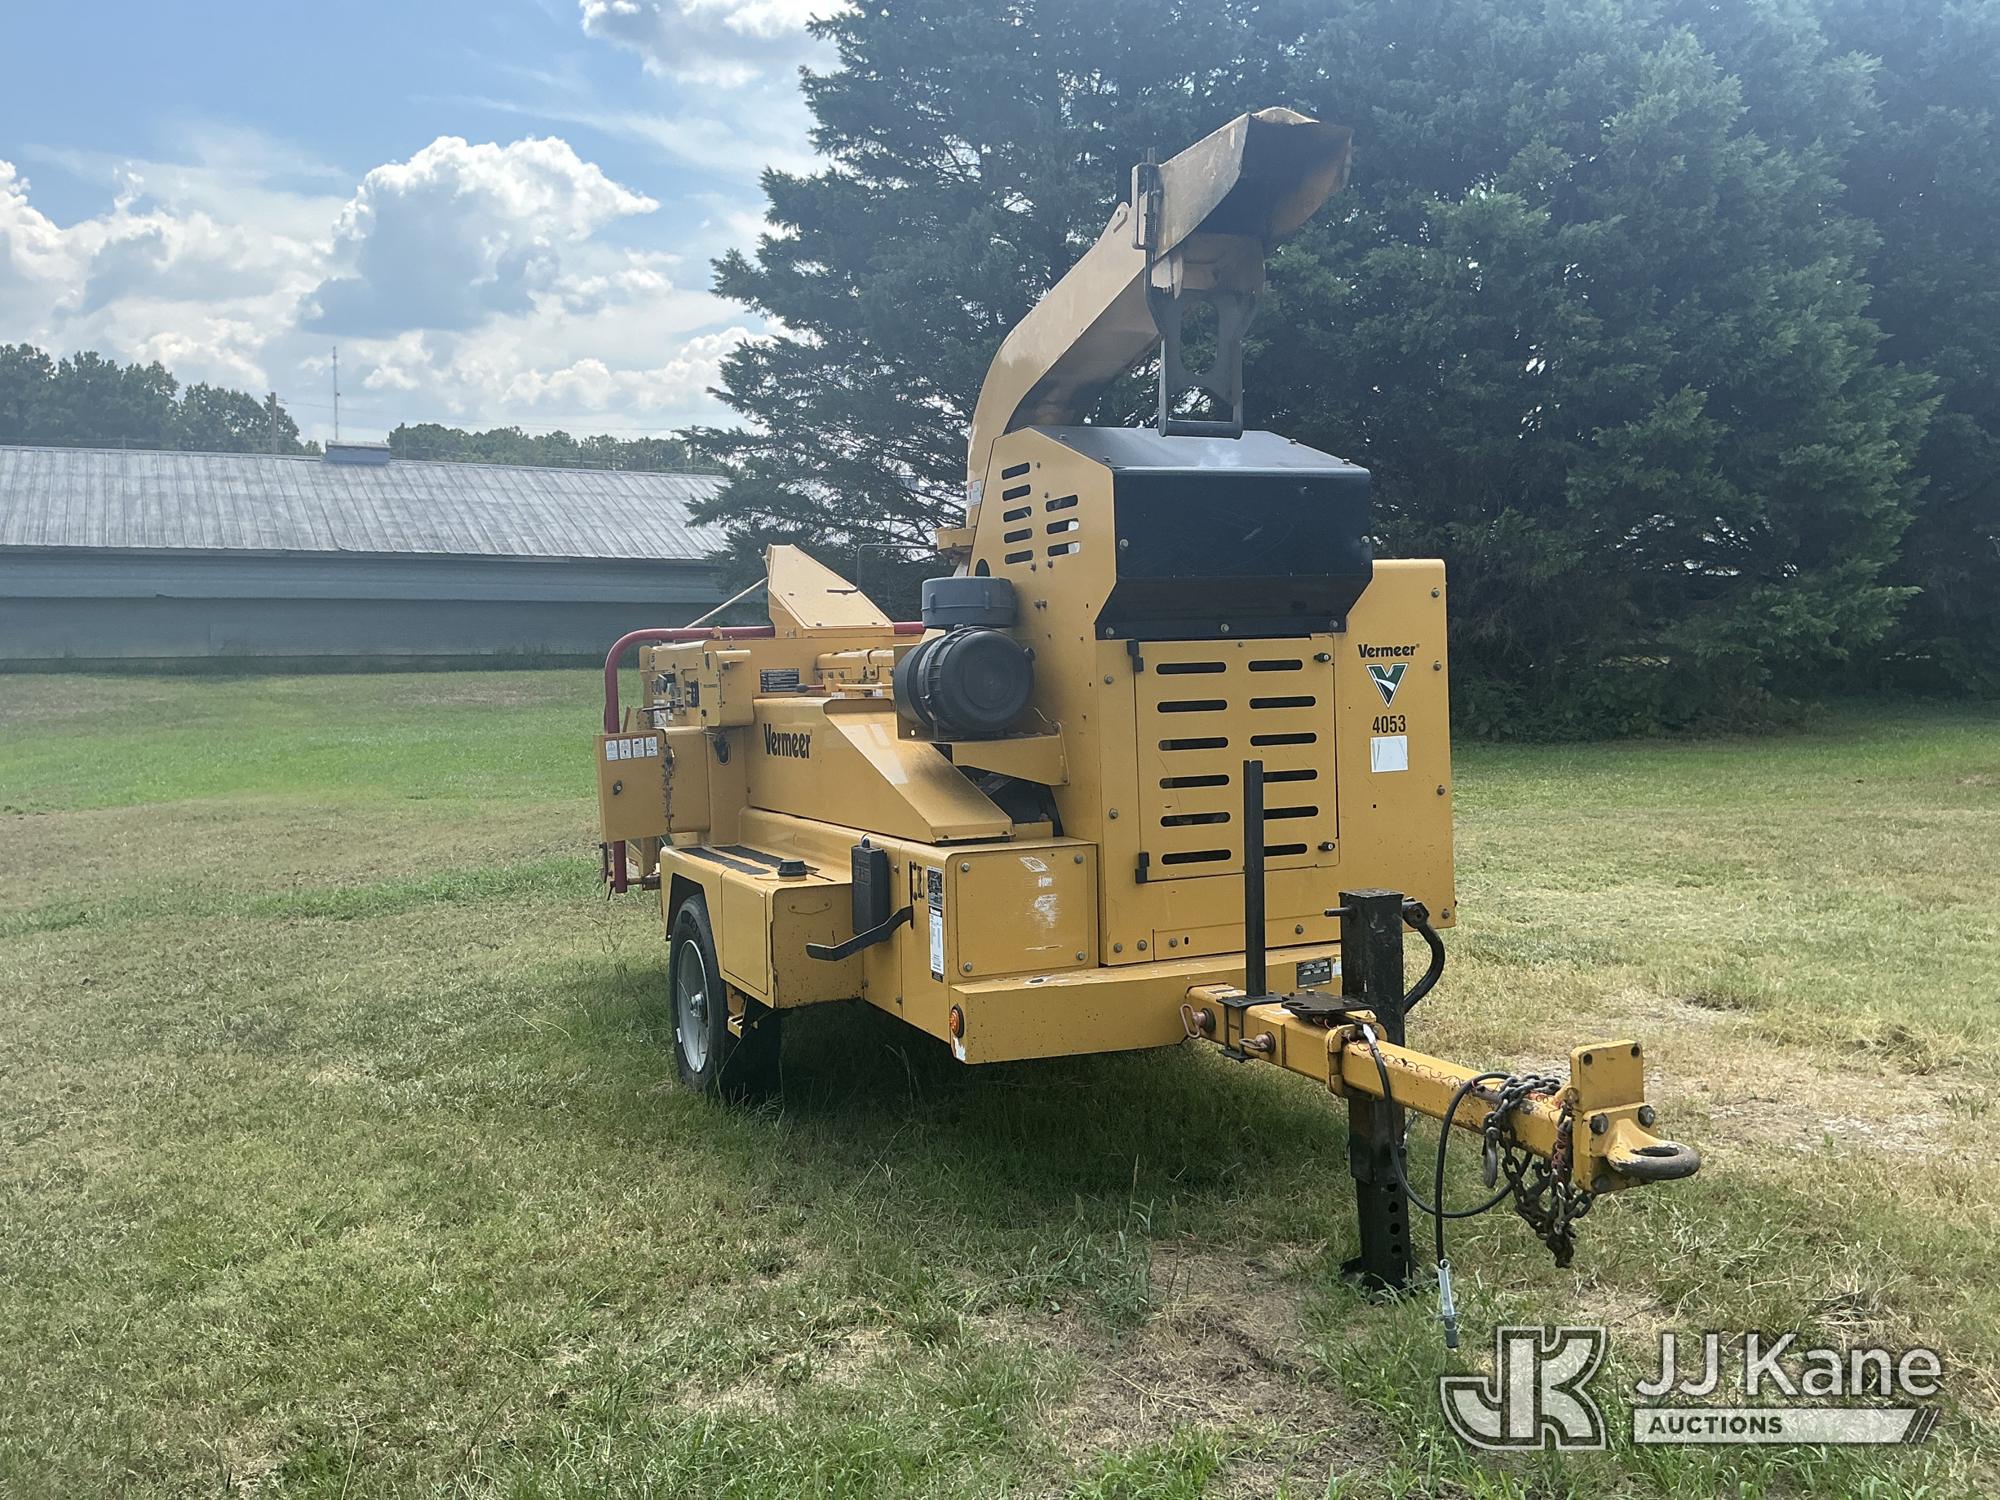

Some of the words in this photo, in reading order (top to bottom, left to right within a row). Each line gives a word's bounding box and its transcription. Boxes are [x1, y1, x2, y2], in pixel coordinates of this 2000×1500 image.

[1358, 643, 1416, 658] Vermeer
[1372, 715, 1406, 734] 4053
[764, 723, 811, 759] Vermeer
